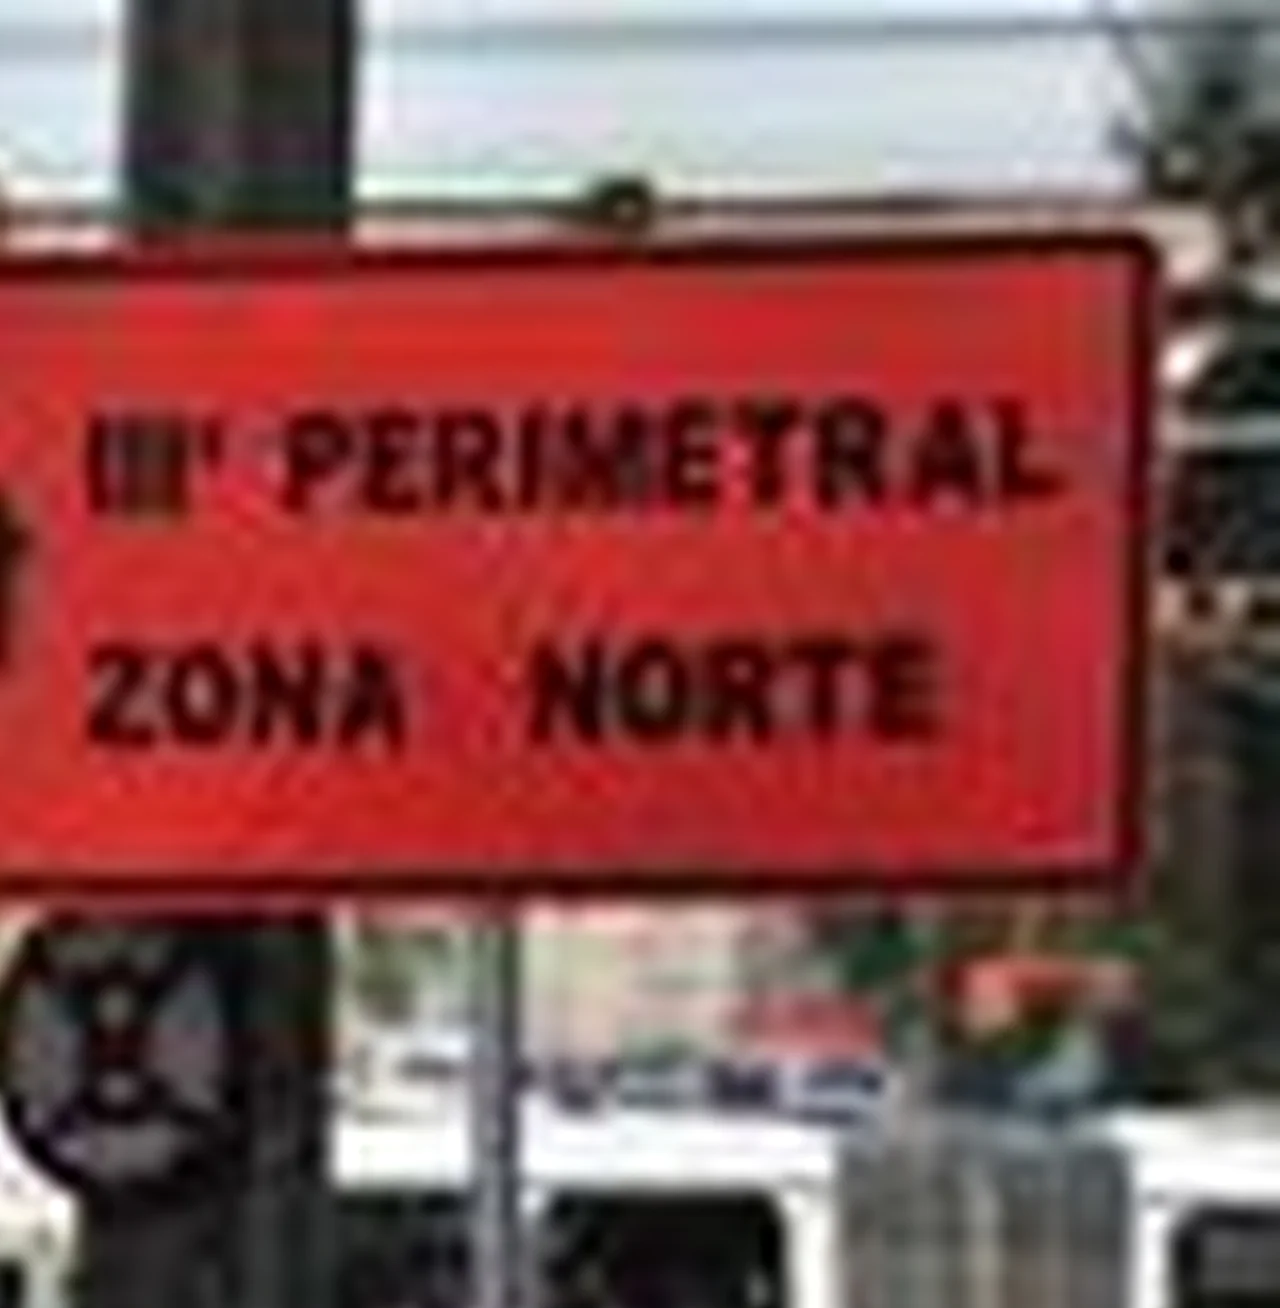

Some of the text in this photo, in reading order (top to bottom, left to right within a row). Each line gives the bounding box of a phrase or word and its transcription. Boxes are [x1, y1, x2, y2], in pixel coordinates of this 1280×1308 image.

[280, 398, 1065, 520] PERIMETRAL
[83, 634, 942, 755] ZONA NORTE
